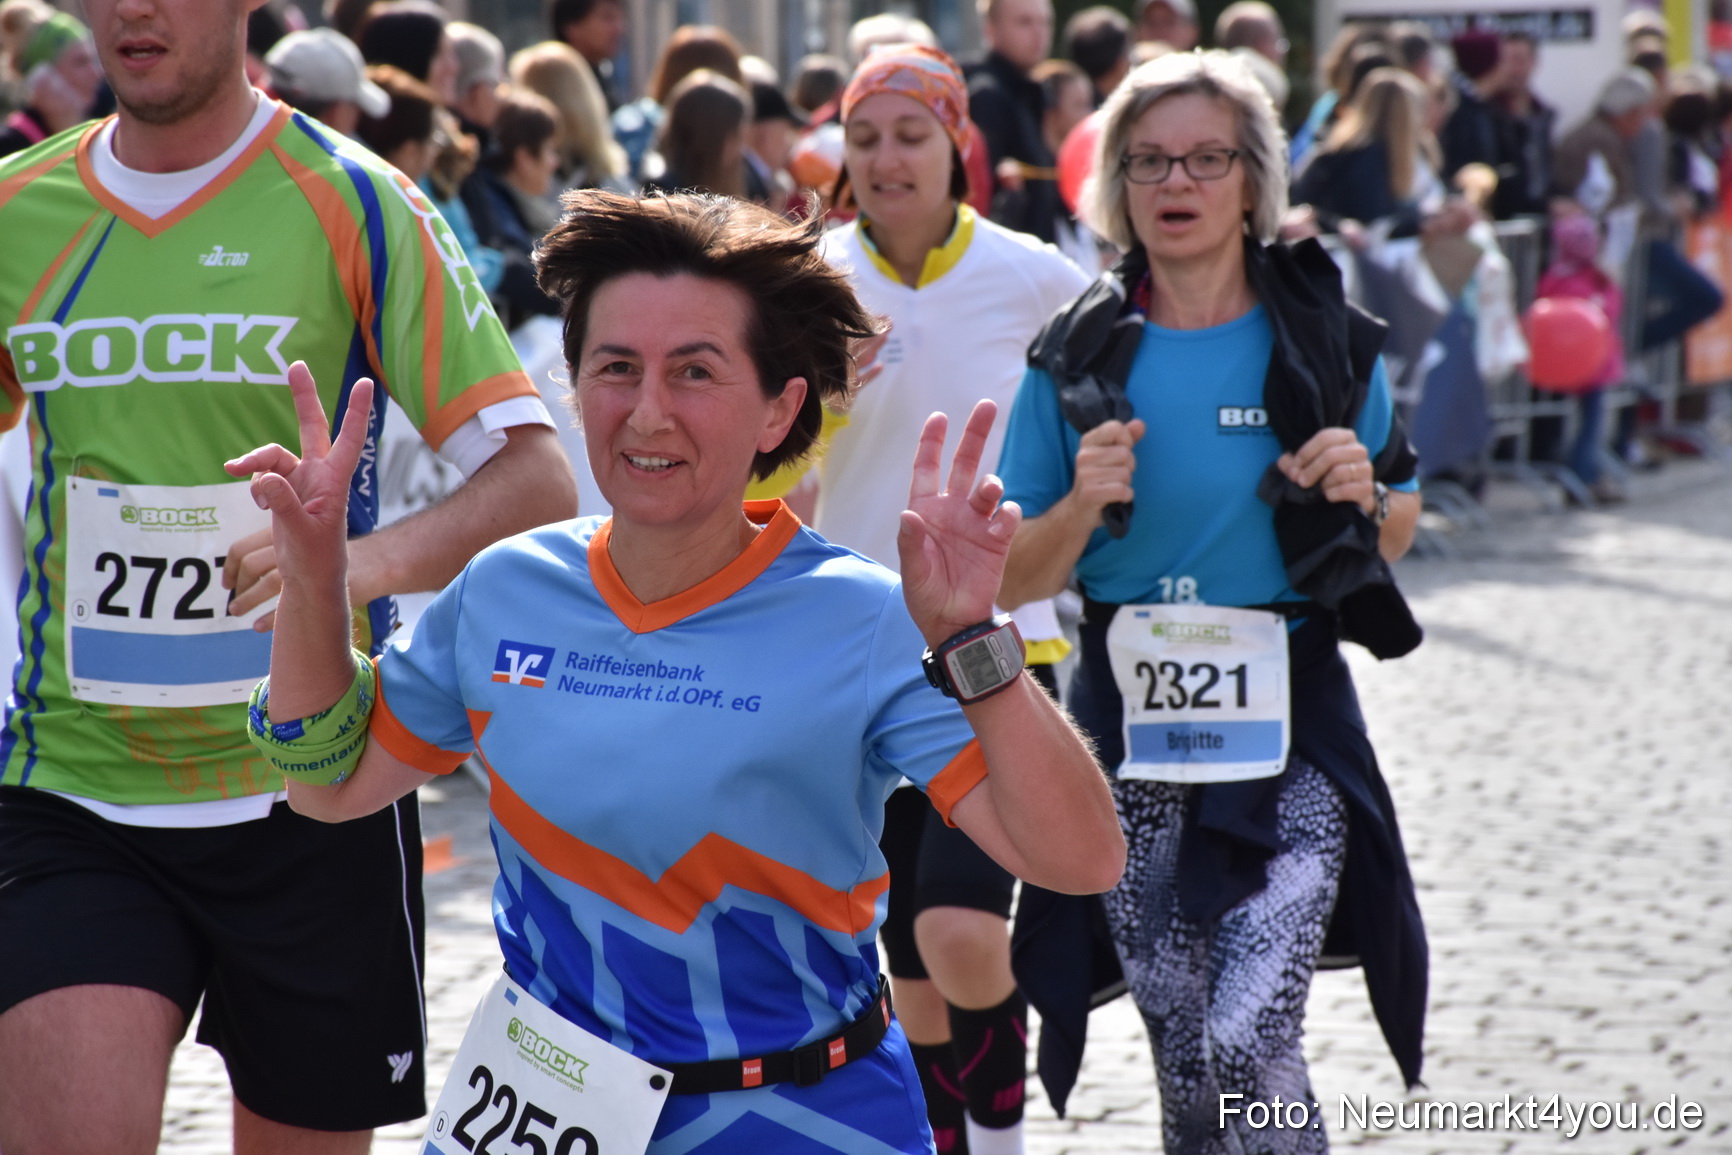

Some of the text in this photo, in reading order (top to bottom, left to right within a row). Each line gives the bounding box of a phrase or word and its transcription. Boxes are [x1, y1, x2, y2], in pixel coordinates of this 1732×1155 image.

[7, 313, 299, 391] BOCK
[139, 507, 219, 526] BOCK
[77, 605, 84, 616] D
[565, 651, 705, 682] Raiffeisenbank
[557, 674, 653, 701] Neumarkt
[731, 695, 762, 712] eG
[1135, 661, 1247, 711] 2321
[519, 1026, 590, 1085] BOCK
[743, 1066, 761, 1075] Braun
[556, 1075, 584, 1093] concepts
[436, 1117, 445, 1132] D
